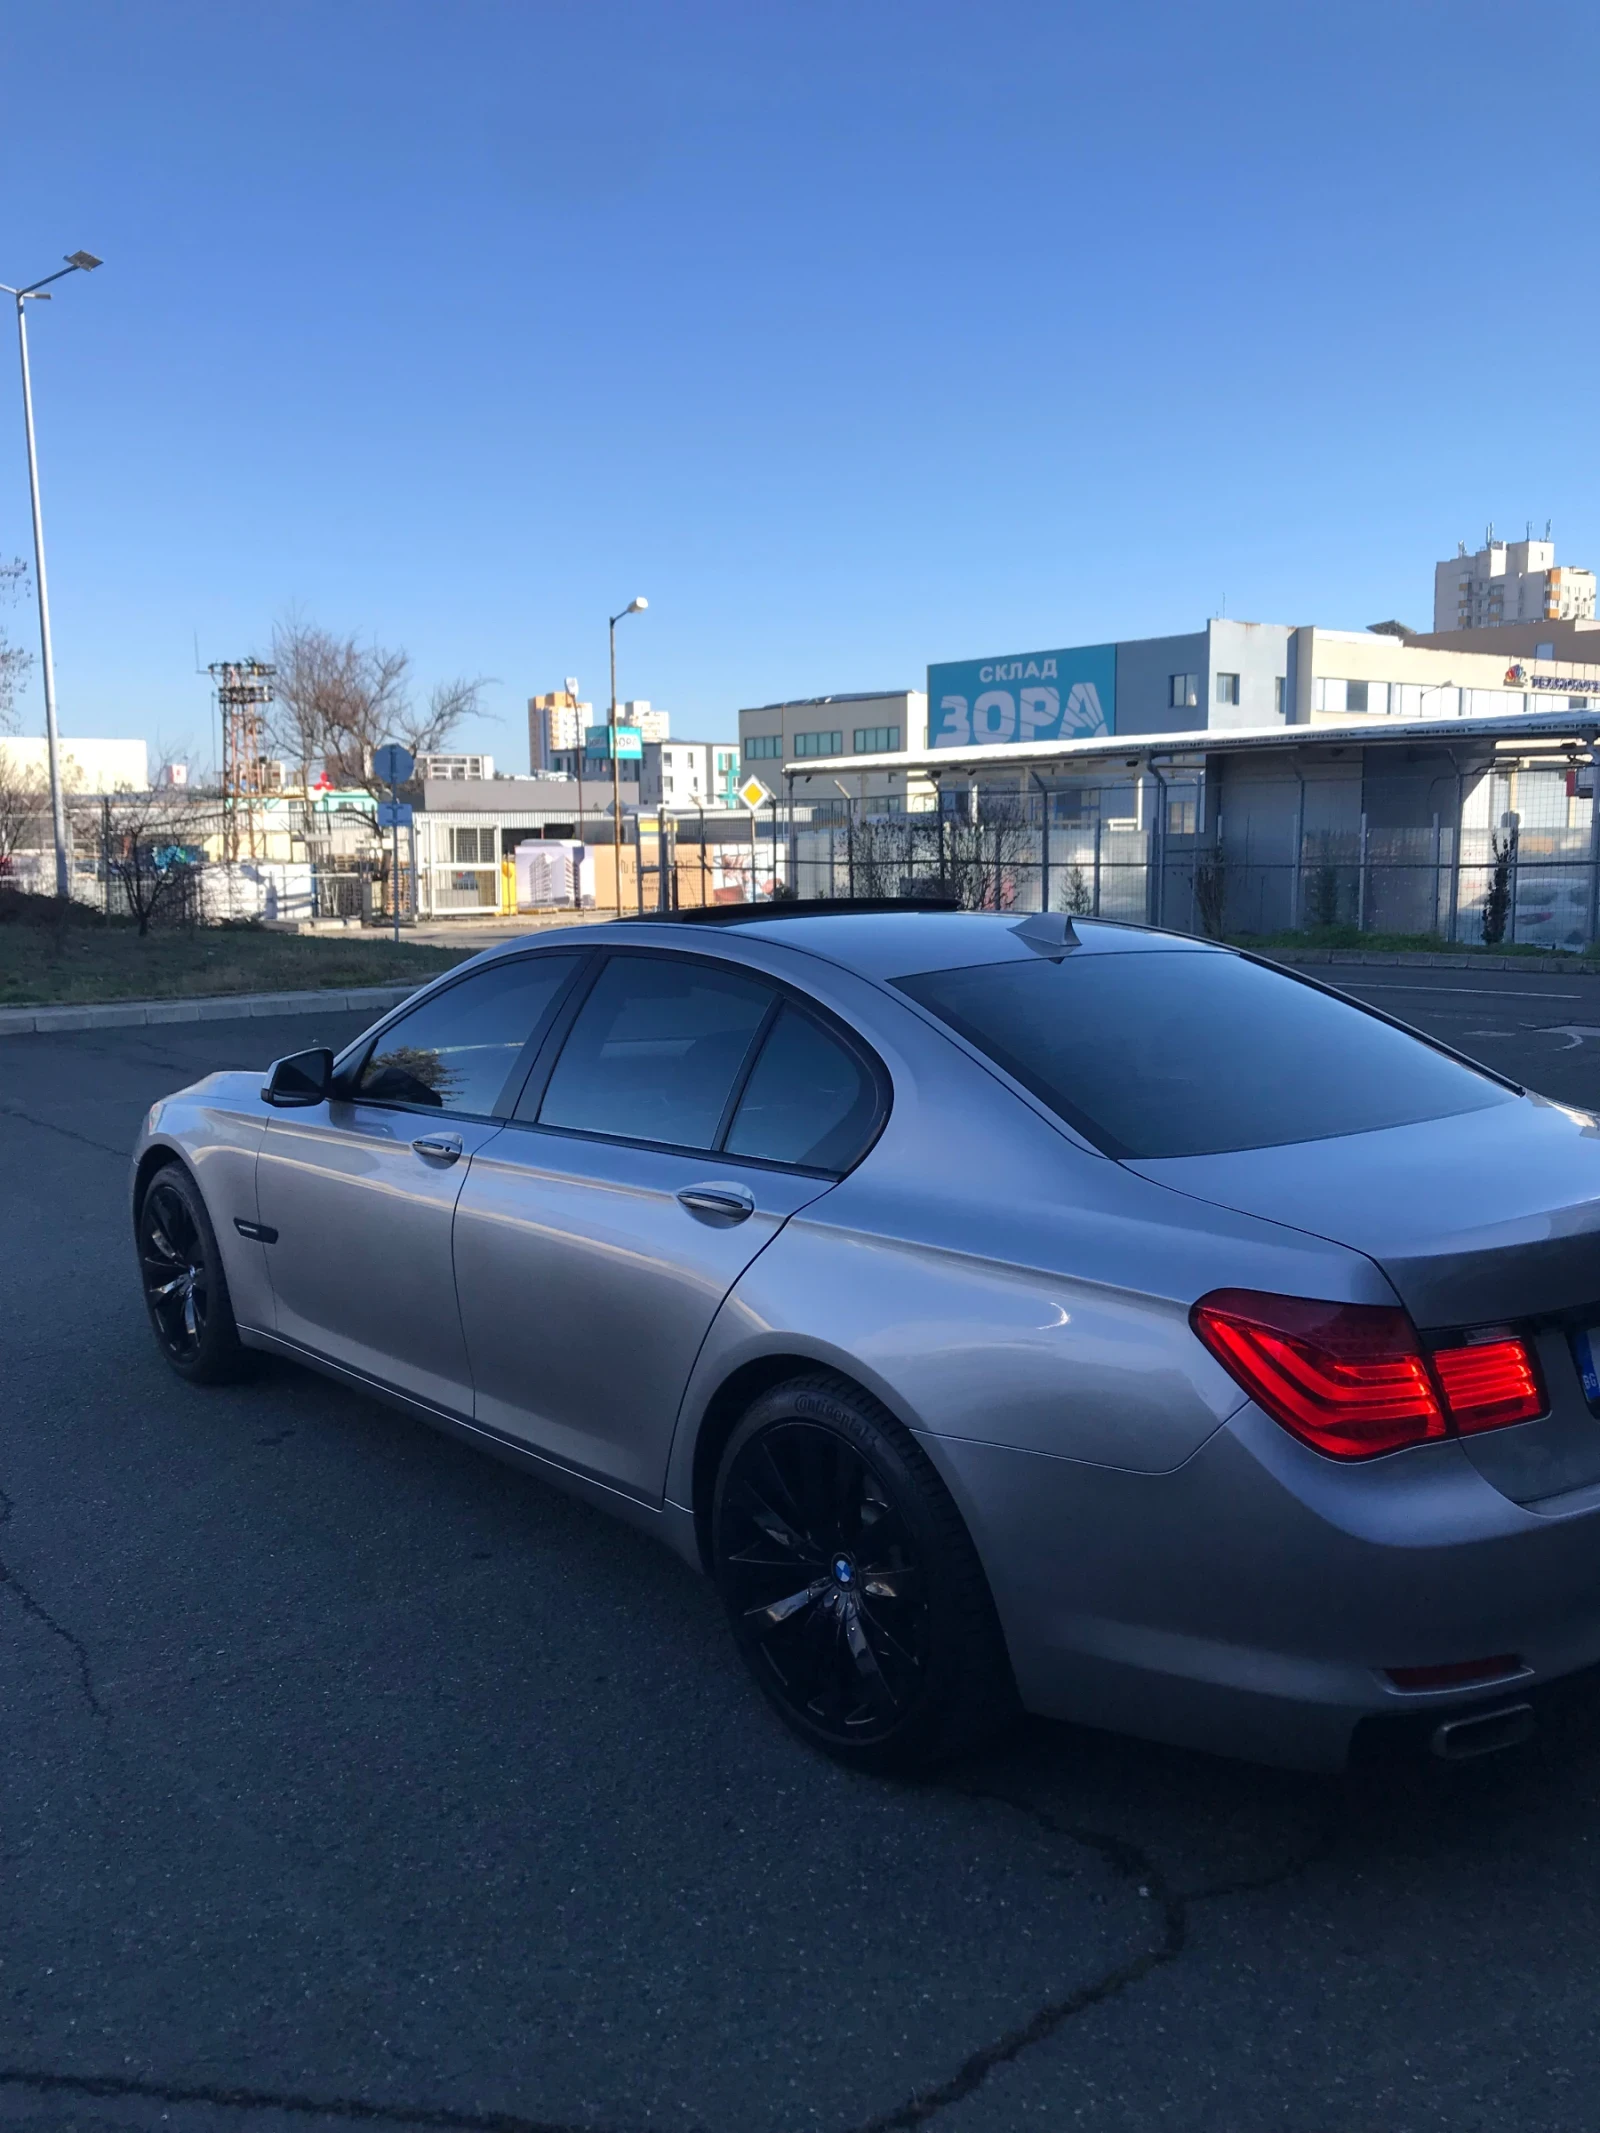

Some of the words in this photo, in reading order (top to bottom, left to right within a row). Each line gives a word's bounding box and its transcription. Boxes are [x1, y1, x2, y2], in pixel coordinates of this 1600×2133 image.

[979, 658, 1058, 683] СКЛАД
[934, 682, 1110, 749] ЗОРА
[1582, 1373, 1598, 1390] BG
